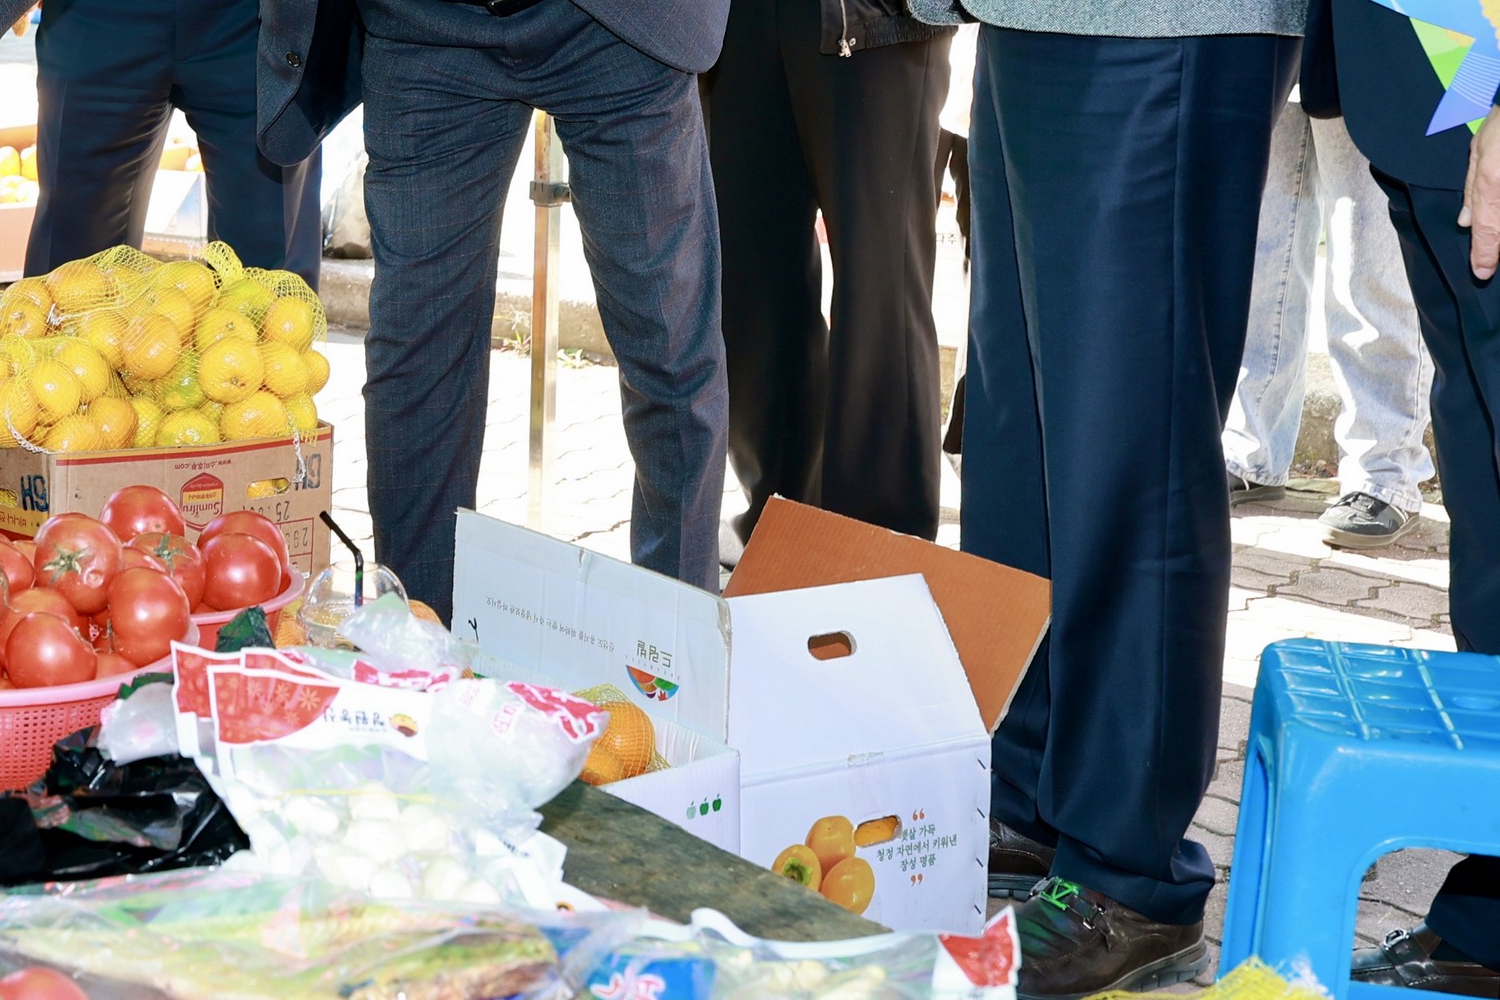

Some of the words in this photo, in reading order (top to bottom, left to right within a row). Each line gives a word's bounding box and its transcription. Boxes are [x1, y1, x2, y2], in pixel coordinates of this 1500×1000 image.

[182, 501, 221, 518] Sumifru
[636, 639, 673, 668] 드림빌
[918, 823, 936, 838] 가득
[876, 846, 894, 862] 청정
[896, 839, 930, 857] 자연에서
[932, 833, 957, 850] 키워낸
[900, 857, 917, 872] 장성
[919, 853, 936, 868] 명품
